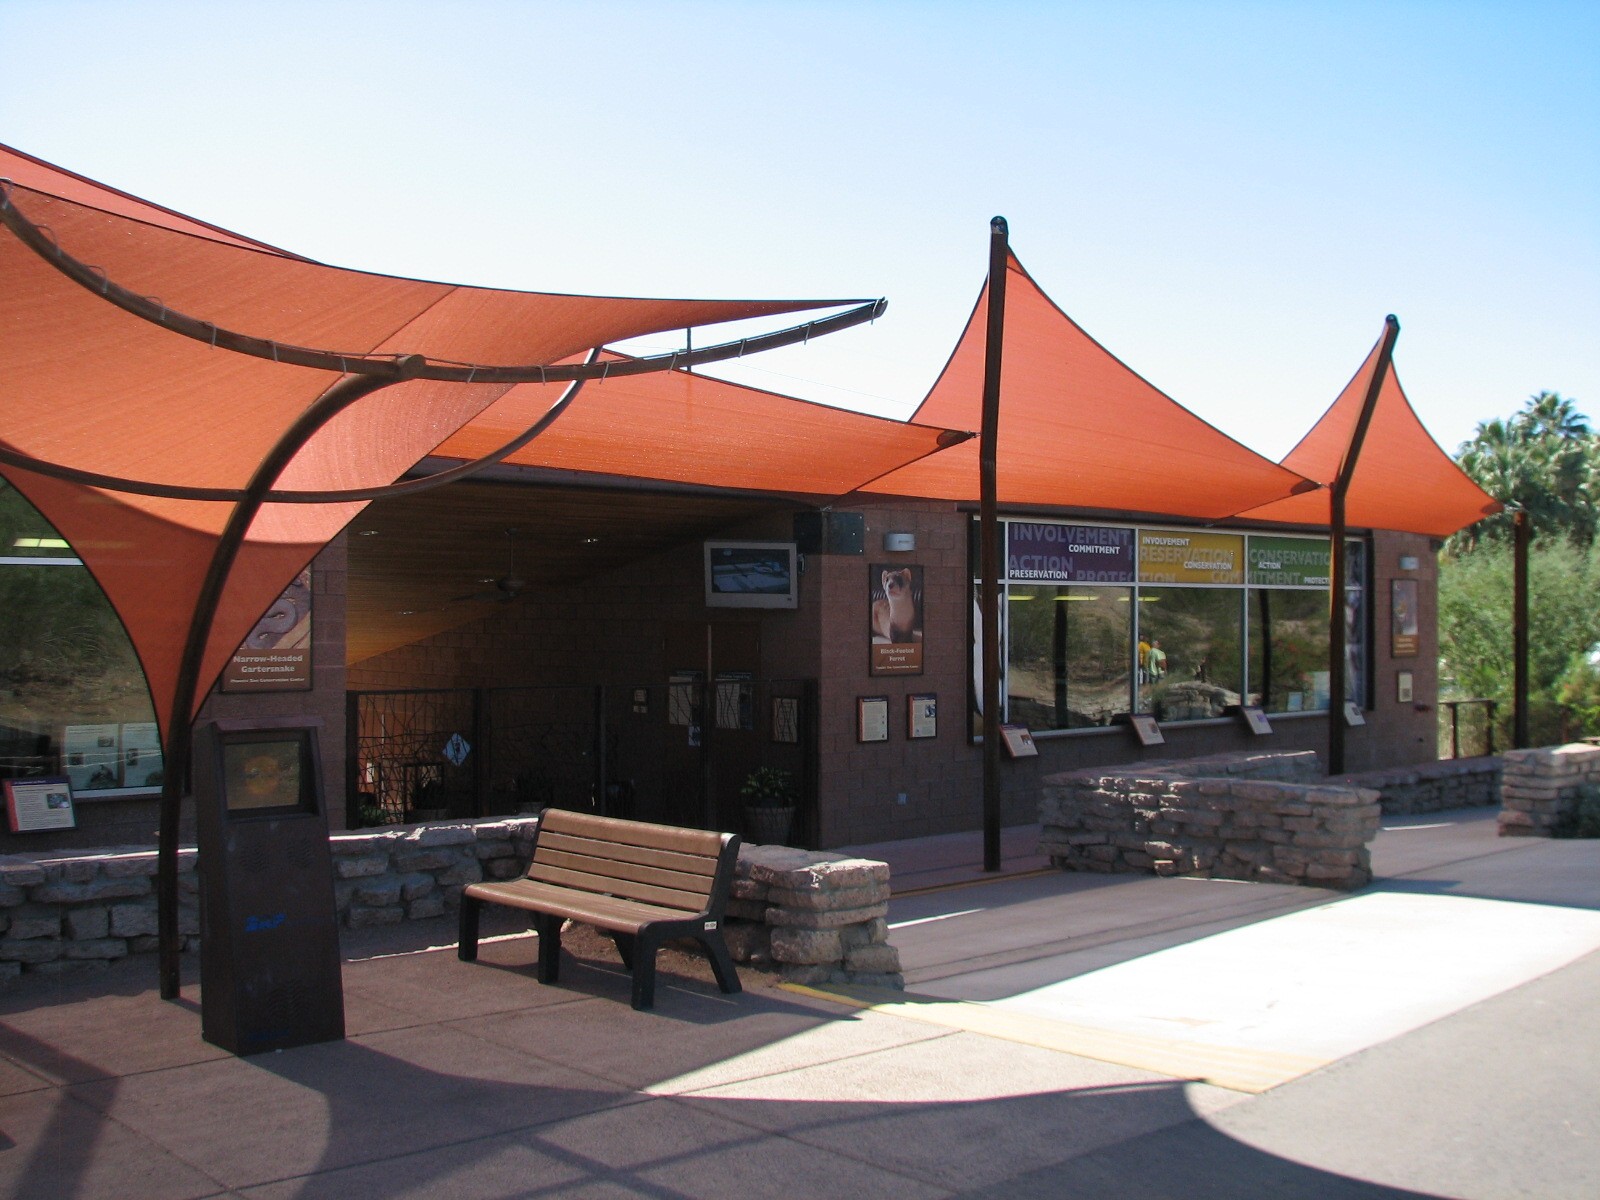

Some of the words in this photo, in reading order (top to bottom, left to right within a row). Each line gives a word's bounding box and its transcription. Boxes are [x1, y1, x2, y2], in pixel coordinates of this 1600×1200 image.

[1013, 523, 1130, 546] INVOLVEMENT
[1142, 536, 1190, 546] INVOLVEMENT
[1068, 544, 1120, 555] COMMITMENT
[1008, 555, 1073, 573] ACTION
[1183, 561, 1233, 571] CONSERVATION
[1258, 561, 1281, 570] ACTION
[1009, 569, 1068, 580] PRESERVATION
[233, 655, 303, 663] Narrow-Headed
[241, 665, 296, 673] Gartersnake
